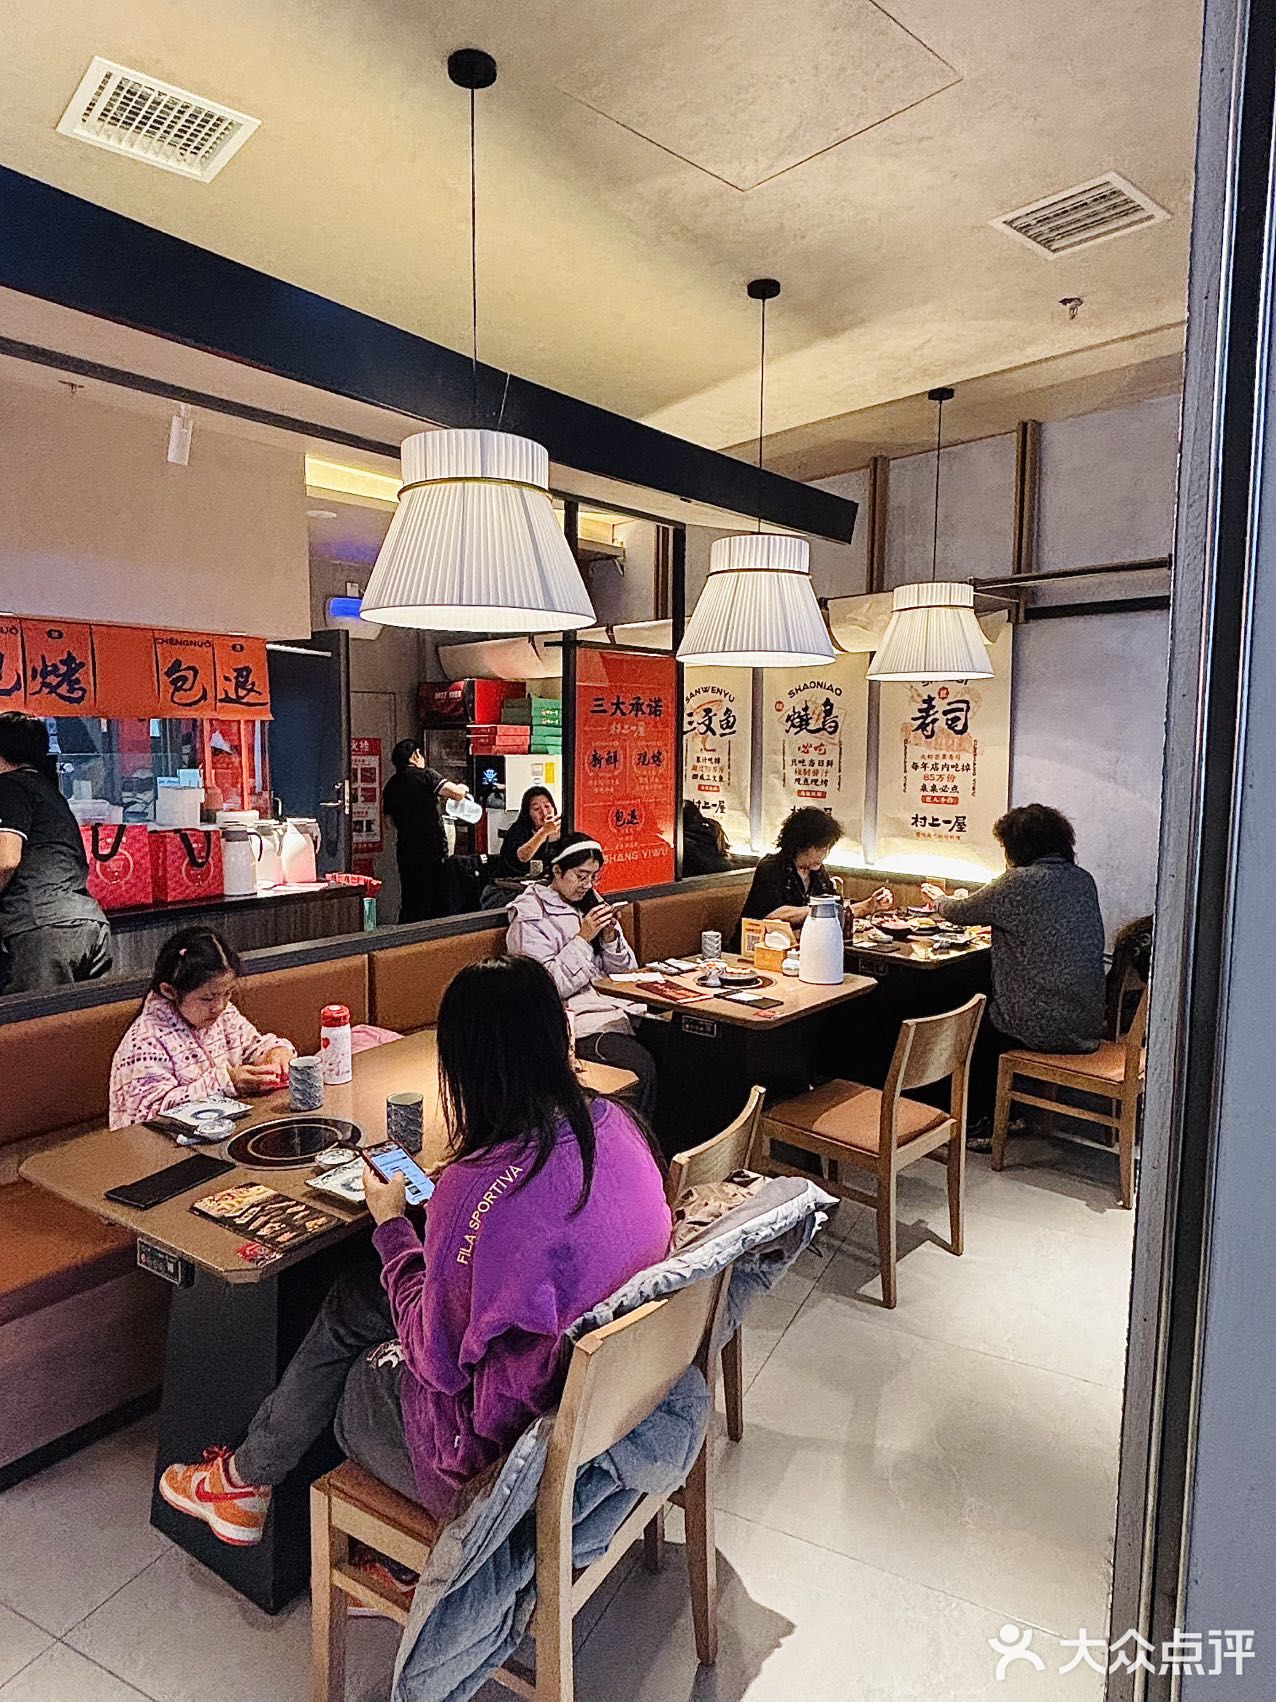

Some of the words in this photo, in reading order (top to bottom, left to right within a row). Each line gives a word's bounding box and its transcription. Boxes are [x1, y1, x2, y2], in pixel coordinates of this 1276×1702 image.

[164, 658, 269, 706] 包退
[787, 681, 842, 698] SHAONIAO
[686, 686, 735, 704] SANWENYU
[589, 695, 663, 717] 三大承诺
[911, 694, 970, 739] 寿司
[911, 762, 971, 773] 每年店内吃掉
[923, 774, 957, 783] 85万份
[911, 813, 967, 832] 村上一屋
[457, 1234, 476, 1265] FILA
[469, 1165, 523, 1230] SPORTIVA
